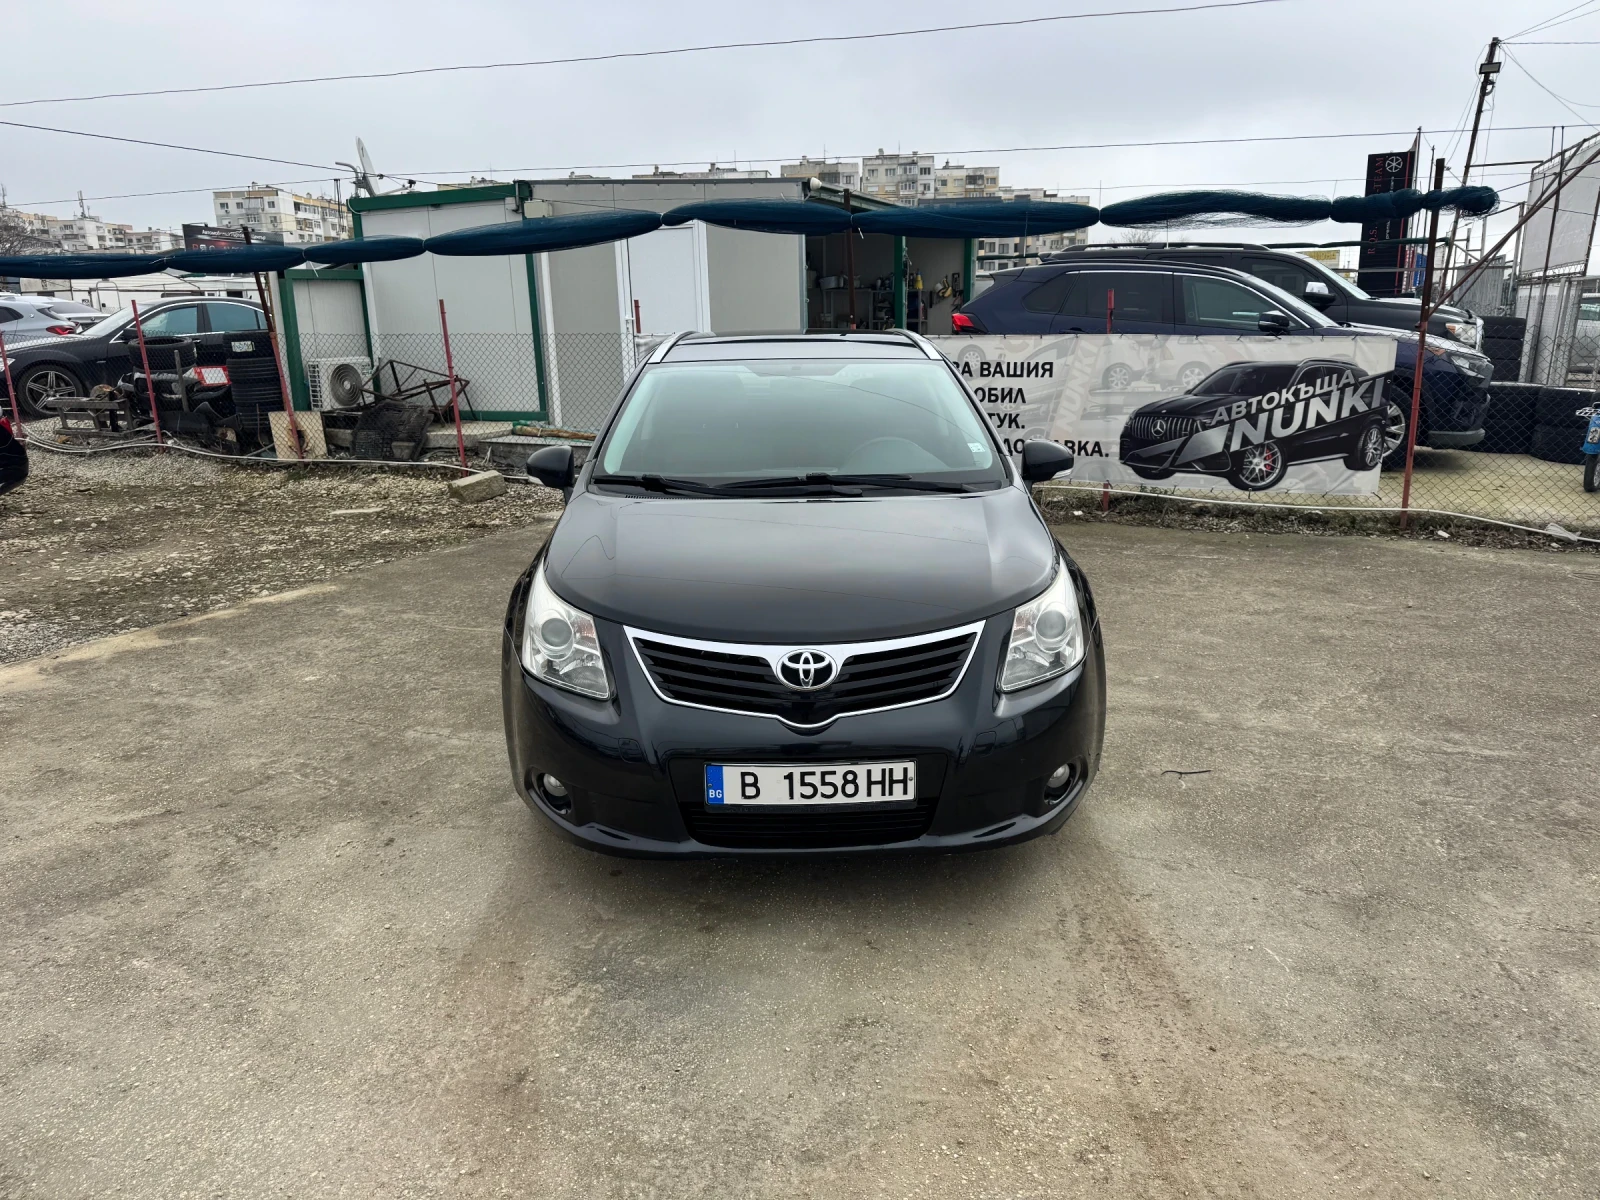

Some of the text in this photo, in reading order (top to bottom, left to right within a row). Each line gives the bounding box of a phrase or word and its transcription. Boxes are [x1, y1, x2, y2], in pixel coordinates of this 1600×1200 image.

[979, 361, 1054, 378] ВАШИЯ
[1210, 369, 1355, 426] АВТОКЪЩА
[1229, 376, 1385, 453] NUNKI
[708, 789, 723, 799] BG
[740, 771, 761, 799] B
[783, 769, 860, 800] 1558
